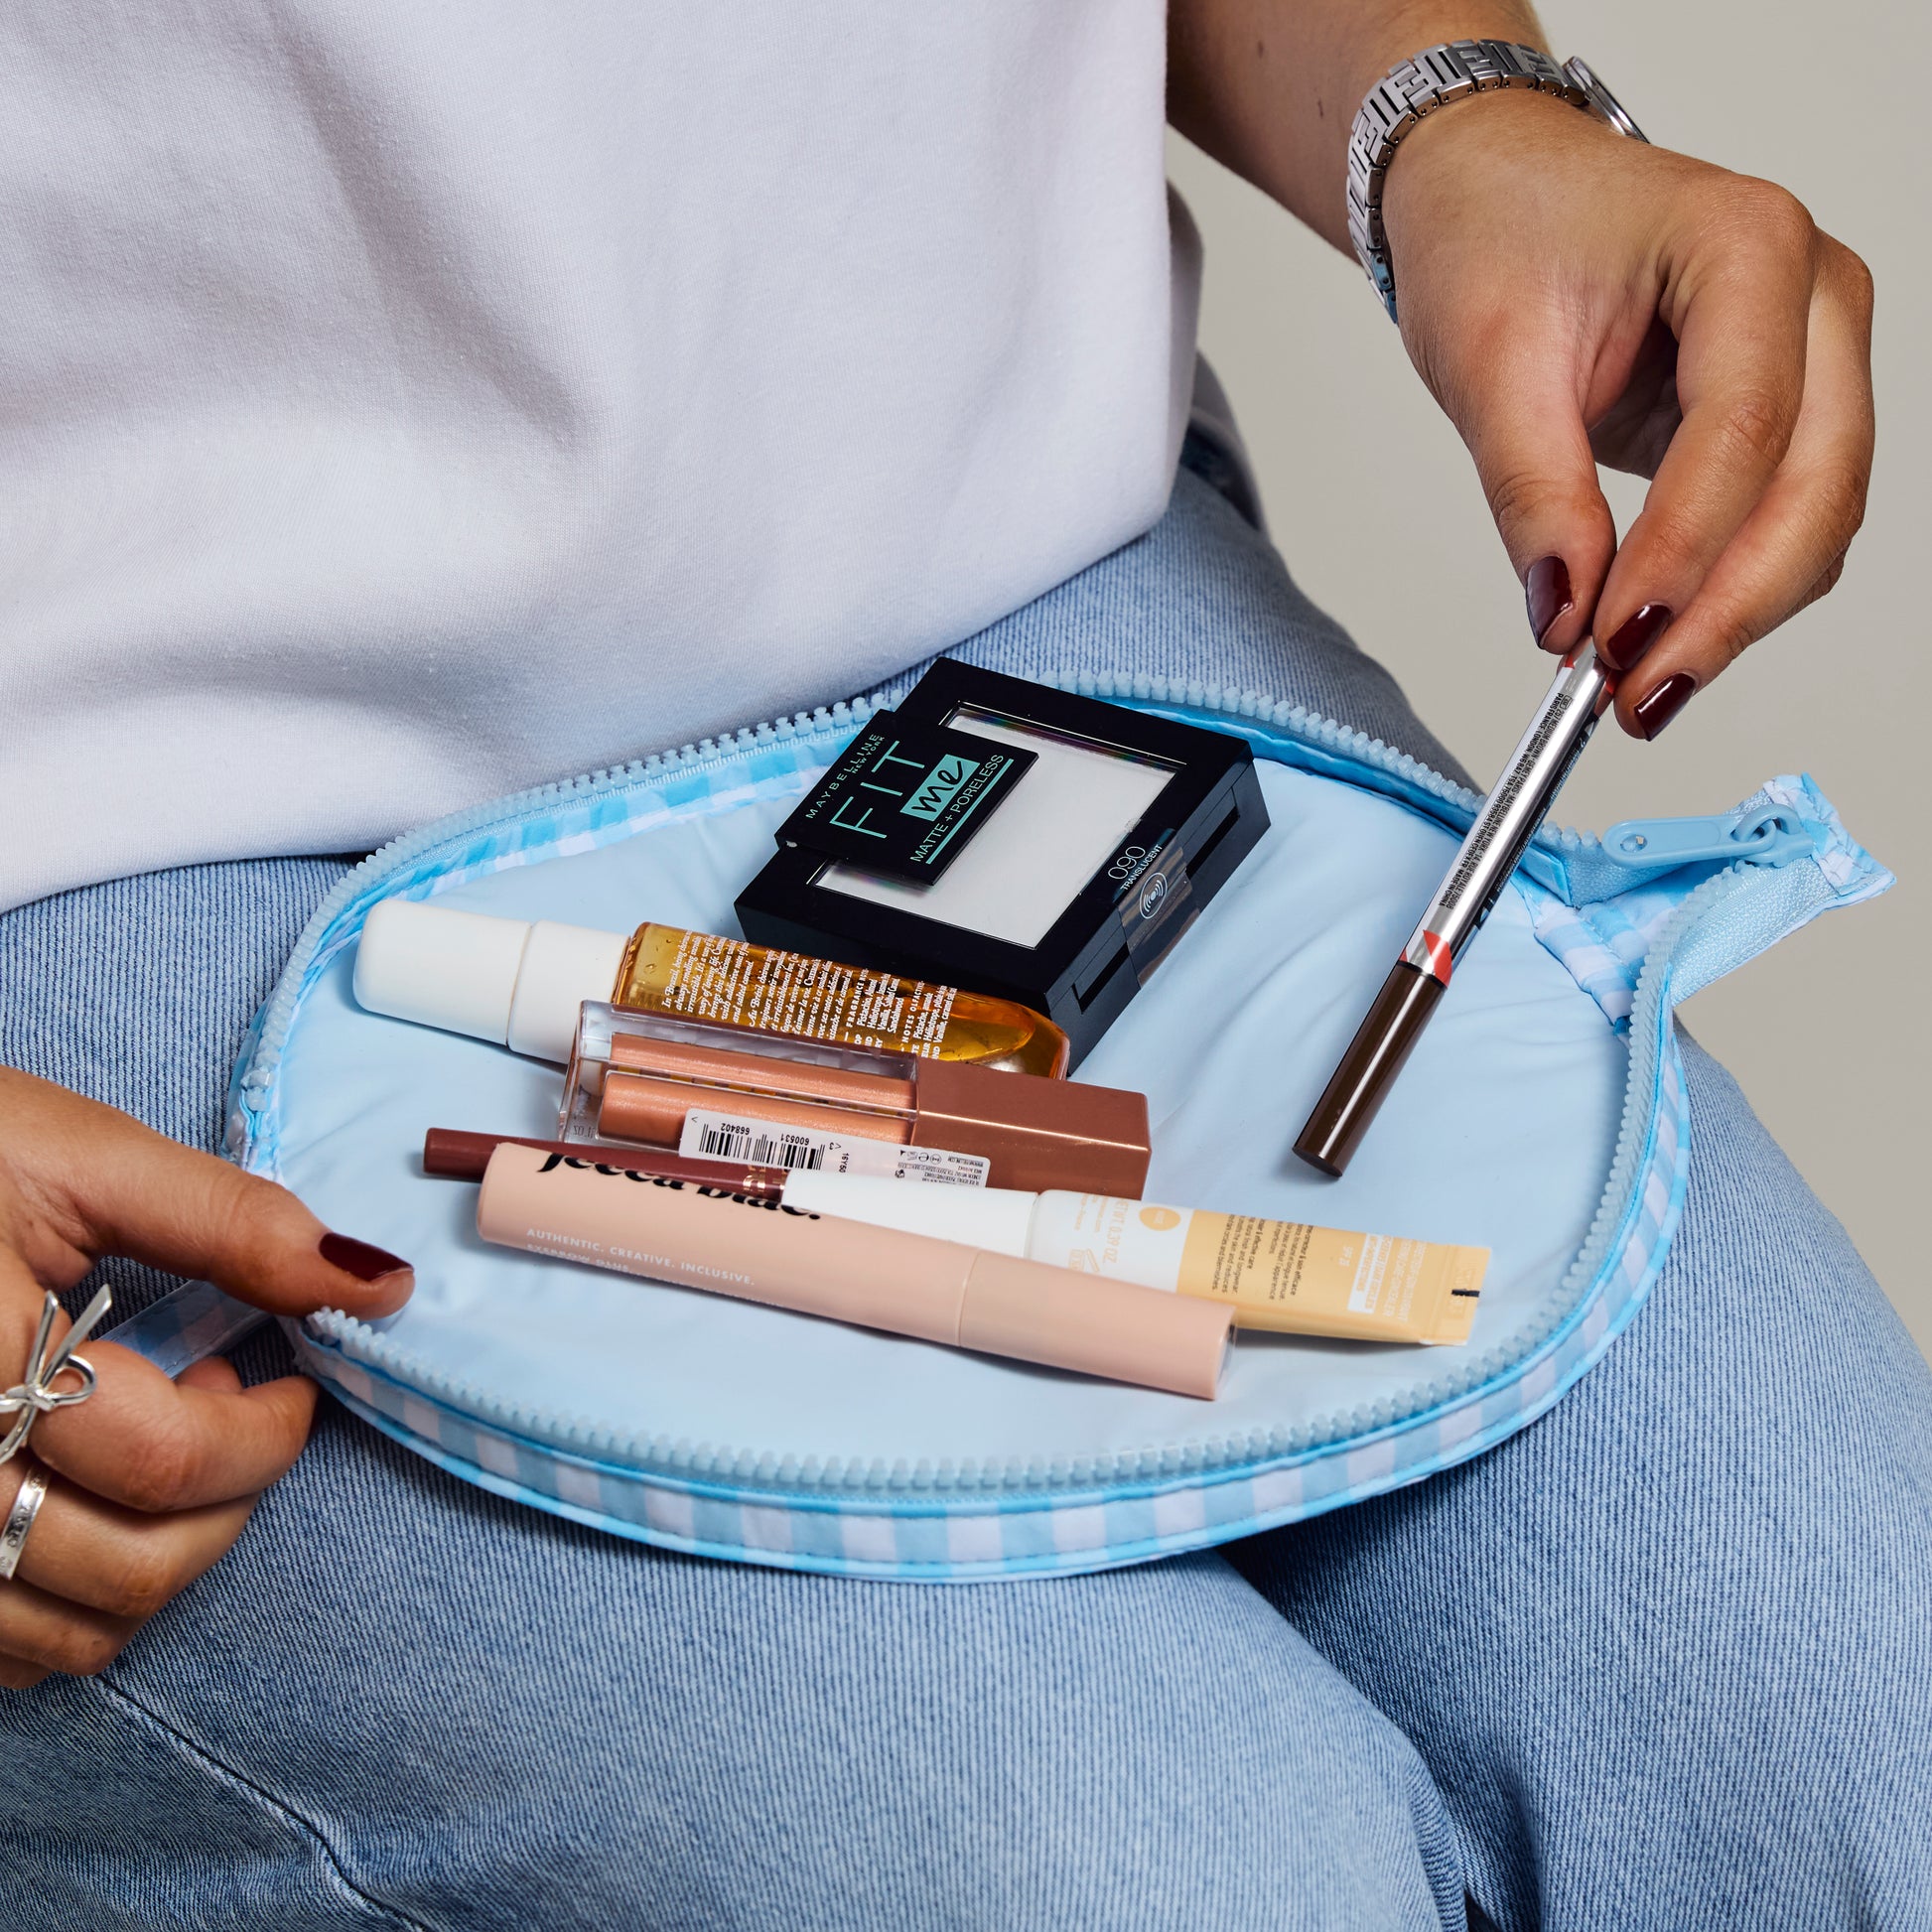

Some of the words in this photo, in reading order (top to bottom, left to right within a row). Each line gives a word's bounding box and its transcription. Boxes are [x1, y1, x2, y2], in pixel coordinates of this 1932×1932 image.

[851, 758, 867, 774] NEW
[866, 737, 886, 756] YORK
[805, 734, 879, 819] MAYBELLINE
[829, 740, 925, 839] FIT
[909, 822, 949, 863] MATTE
[951, 754, 1005, 814] PORELESS
[1108, 846, 1146, 880] 090
[1120, 844, 1163, 891] TRANSLUCENT
[674, 983, 690, 1011] always
[682, 955, 698, 982] smelling
[702, 966, 719, 989] loving
[714, 979, 724, 992] this
[725, 968, 739, 1000] addictive
[767, 978, 776, 998] sentir
[661, 997, 672, 1008] In
[684, 974, 702, 1012] irresistible.
[736, 983, 747, 1006] salted
[788, 984, 799, 1002] vivre
[846, 982, 864, 1028] FRAGRANCE
[698, 997, 711, 1015] way
[707, 993, 723, 1018] brings
[720, 1000, 731, 1020] with
[732, 1005, 741, 1023] and
[785, 1003, 794, 1013] de
[887, 997, 903, 1033] Sandalwood
[748, 1009, 758, 1027] Au
[817, 1023, 826, 1037] vec
[826, 1014, 840, 1040] istache
[901, 1015, 914, 1042] NOTES
[874, 1037, 883, 1048] RY
[720, 1122, 750, 1135] 668402
[779, 1133, 809, 1145] 600531
[526, 1228, 604, 1252] AUTHENTIC.
[610, 1246, 675, 1268] CREATIVE.
[681, 1262, 755, 1285] INCLUSIVE.
[1246, 1256, 1255, 1269] care
[1290, 1270, 1301, 1296] efficace
